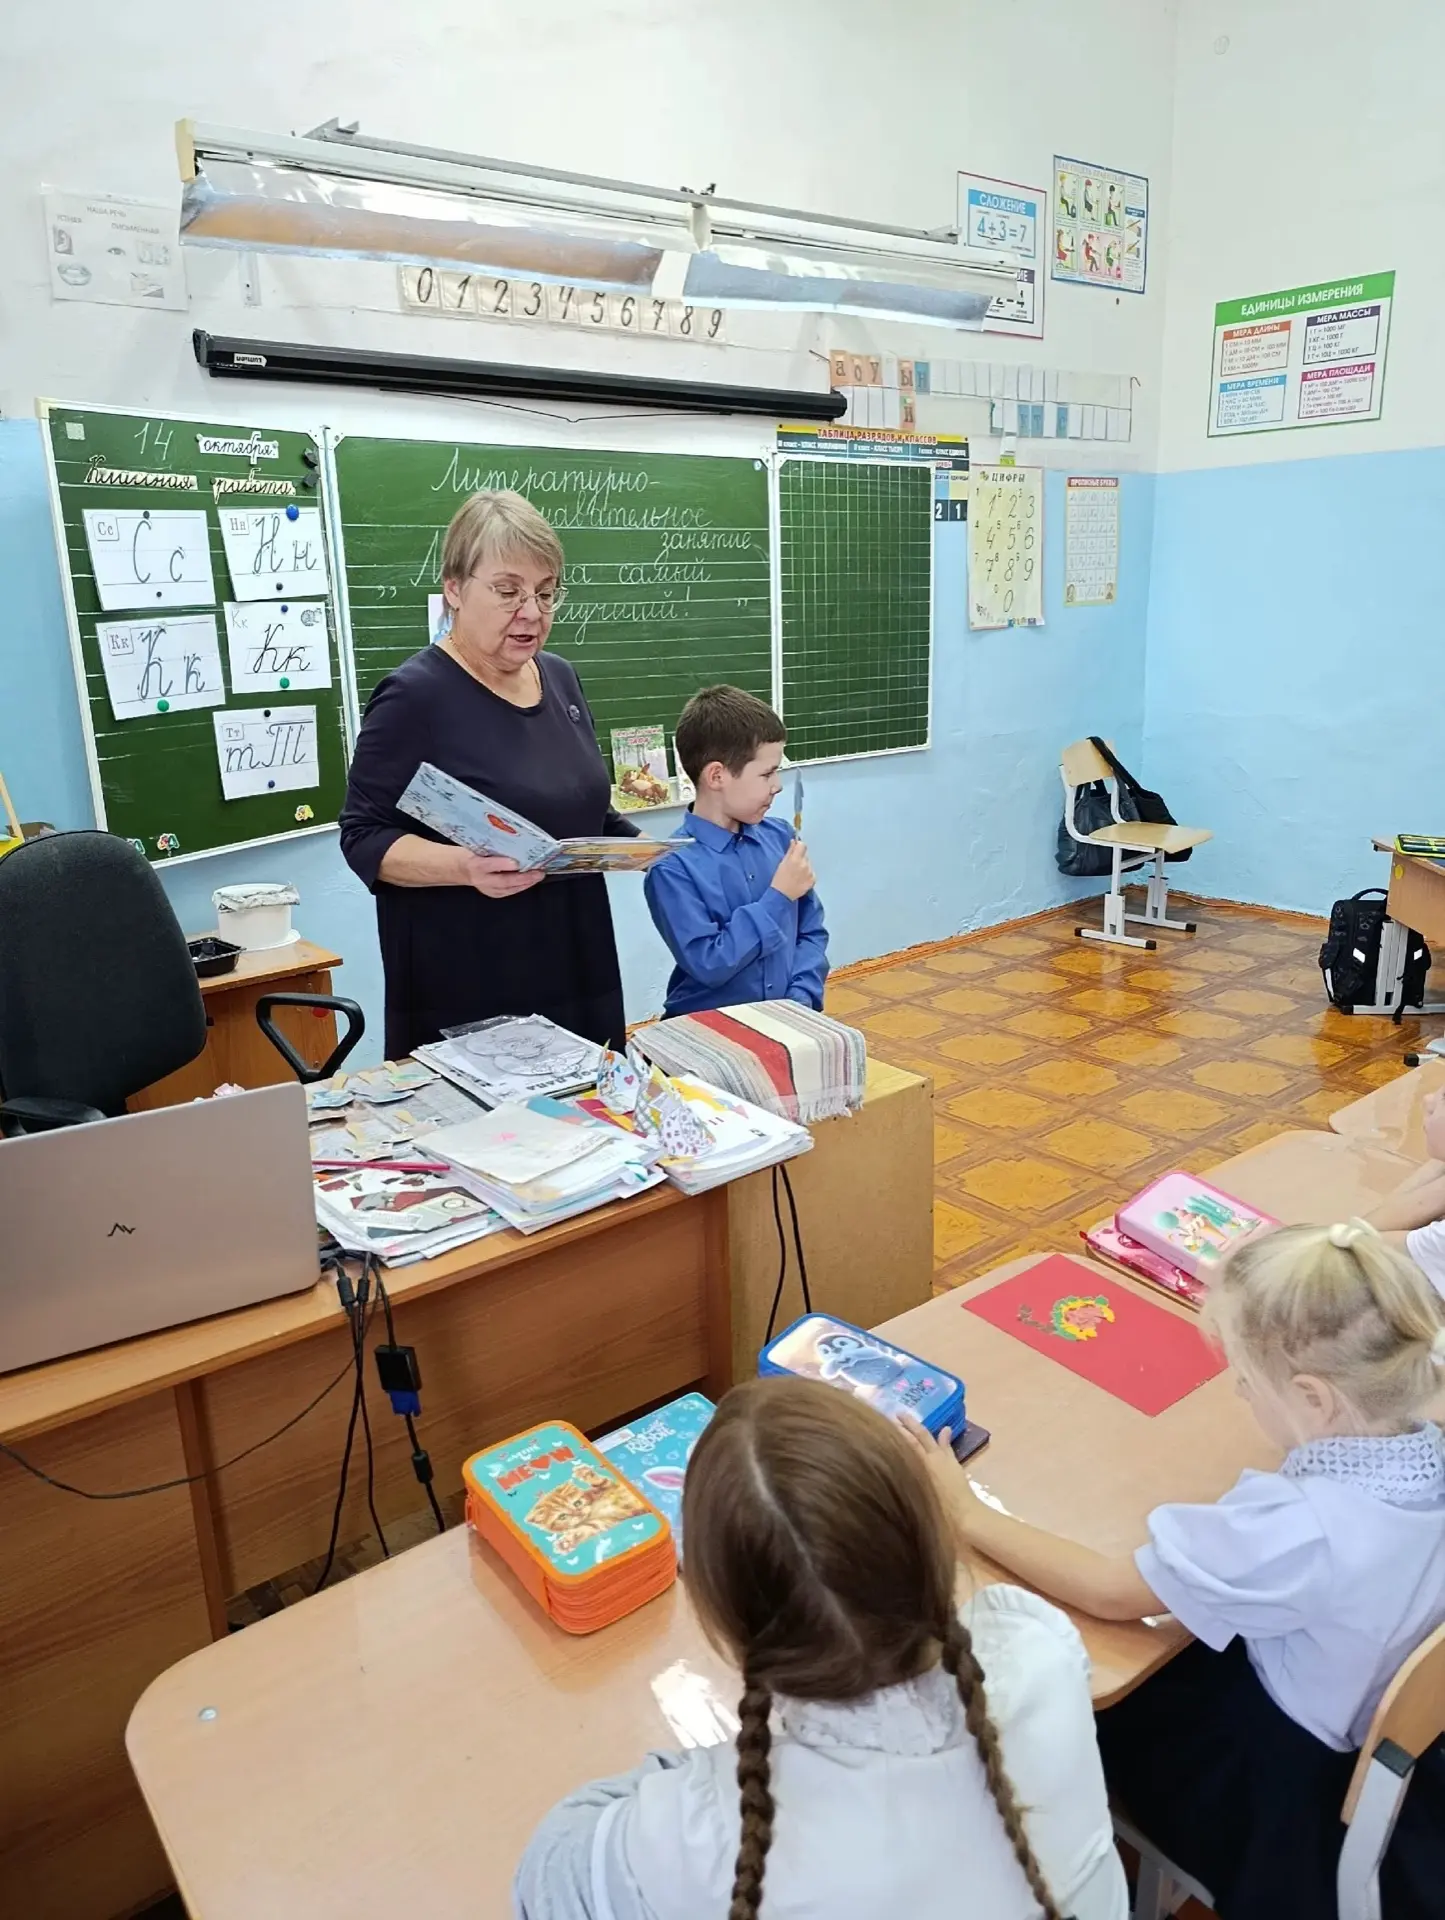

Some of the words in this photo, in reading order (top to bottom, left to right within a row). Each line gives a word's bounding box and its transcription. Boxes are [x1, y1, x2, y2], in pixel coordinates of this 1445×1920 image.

[87, 206, 108, 214] НАША
[979, 193, 1026, 215] СЛОЖЕНИЕ
[977, 216, 985, 235] 4
[1000, 221, 1006, 239] 3
[1020, 224, 1027, 242] 7
[417, 268, 433, 303] 0
[457, 275, 471, 308] 1
[494, 280, 508, 314] 2
[524, 282, 541, 316] 3
[558, 286, 573, 319] 4
[590, 293, 605, 323] 5
[620, 297, 635, 326] 6
[651, 299, 665, 330] 7
[679, 306, 693, 335] 8
[707, 309, 722, 338] 9
[1241, 295, 1295, 316] ЕДИНИЦЫ
[1297, 283, 1364, 305] ИЗМЕРЕНИЯ
[1317, 314, 1338, 324] МЕРА
[1339, 308, 1371, 321] МАССЫ
[1233, 328, 1252, 338] МЕРА
[1254, 323, 1280, 335] ДЛИНЫ
[1227, 381, 1246, 390] МЕРА
[1247, 377, 1280, 388] ВРЕМЕНИ
[1307, 370, 1328, 380] МЕРА
[1329, 364, 1371, 378] ПЛОЩАДИ
[134, 421, 172, 460] 14
[818, 429, 854, 440] ТАБЛИЦА
[858, 431, 894, 443] РАЗРЯДОВ
[905, 434, 937, 444] КЛАССОВ
[87, 456, 195, 490] Классная
[431, 447, 661, 513] Литературно-
[991, 472, 1026, 484] ЦИФРЫ
[540, 490, 713, 529] навательное
[935, 502, 943, 519] 2
[955, 503, 961, 518] 1
[988, 494, 997, 518] 1
[1008, 494, 1018, 519] 2
[1025, 495, 1035, 519] 3
[98, 523, 114, 537] Сс
[229, 516, 246, 532] Нн
[253, 514, 284, 576] Н
[292, 540, 317, 571] н
[986, 526, 996, 550] 4
[1007, 526, 1016, 550] 5
[1024, 526, 1034, 550] 6
[132, 519, 152, 584] С
[169, 546, 185, 583] с
[654, 531, 752, 571] занятие
[619, 557, 711, 584] самый
[985, 558, 994, 582] 7
[1004, 558, 1015, 582] 8
[1024, 558, 1034, 582] 9
[1003, 589, 1014, 613] 0
[110, 632, 130, 651] Кк
[138, 627, 173, 701] К
[183, 655, 206, 694] к
[226, 727, 240, 739] Тт
